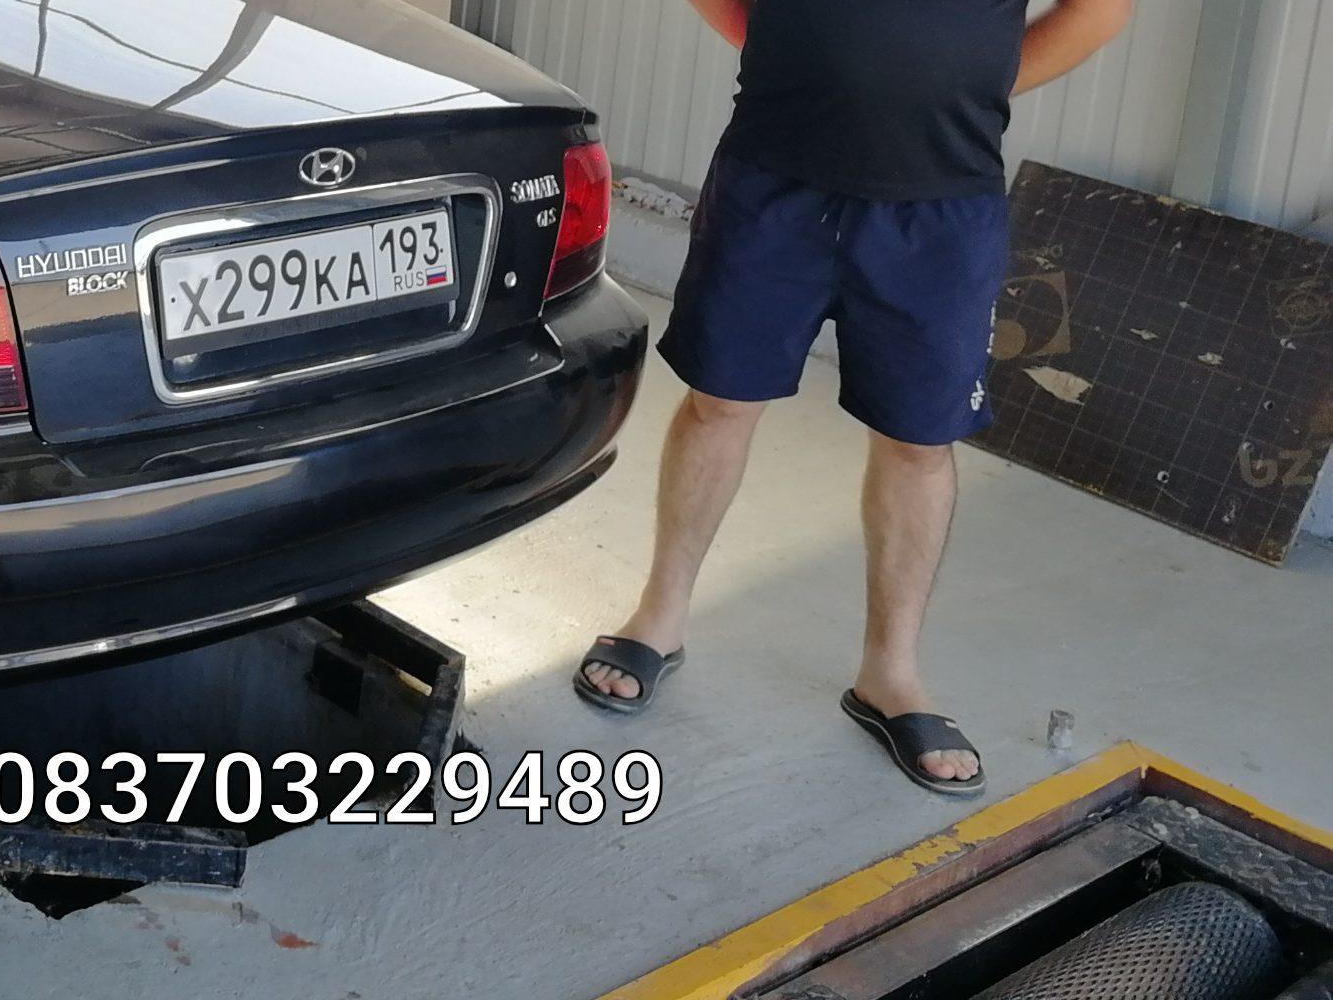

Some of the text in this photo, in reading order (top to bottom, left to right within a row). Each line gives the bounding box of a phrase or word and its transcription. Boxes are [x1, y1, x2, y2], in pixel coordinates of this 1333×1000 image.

[510, 175, 560, 203] SONATA
[537, 207, 556, 227] GLS
[379, 221, 438, 274] 193
[17, 244, 127, 278] HYUNDAI
[67, 271, 128, 296] BLOCK
[393, 270, 425, 292] RUS
